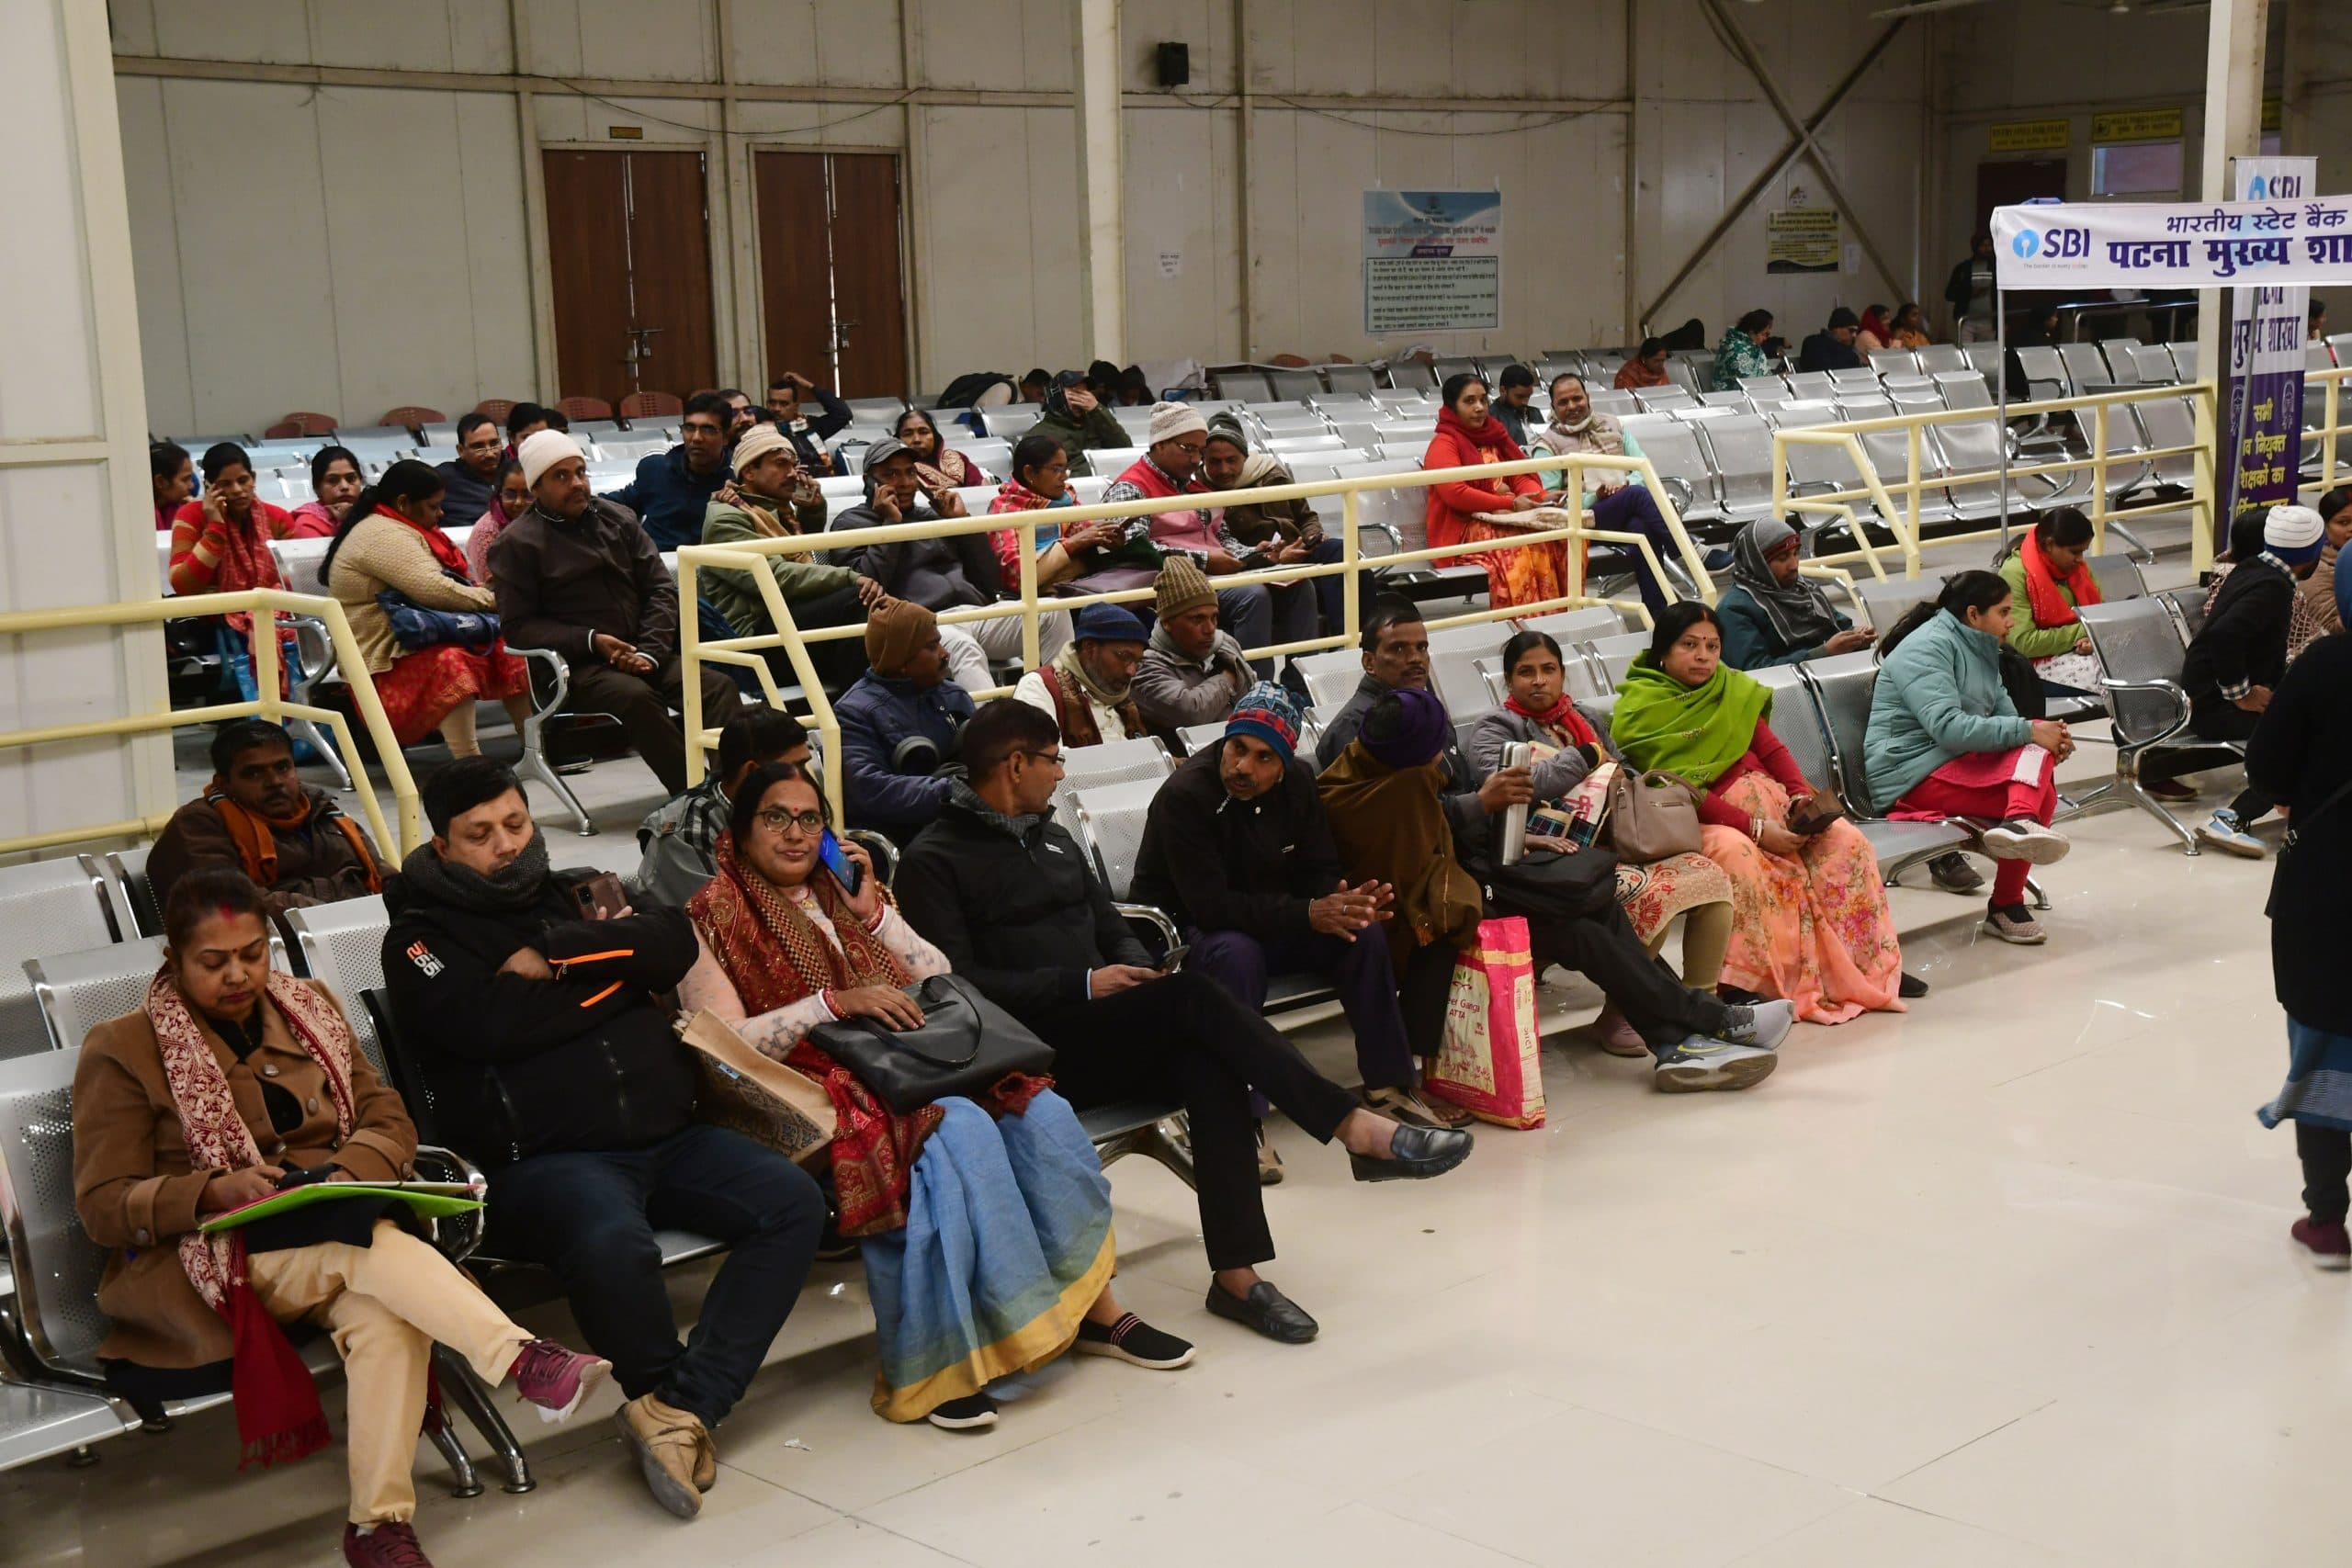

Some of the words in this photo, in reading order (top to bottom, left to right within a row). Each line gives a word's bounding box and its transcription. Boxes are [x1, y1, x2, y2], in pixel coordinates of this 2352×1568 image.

[2167, 210, 2242, 233] भारतीय
[2253, 207, 2296, 231] स्टेट
[2306, 203, 2347, 229] बैंक
[2042, 228, 2090, 258] SBI
[2108, 240, 2191, 268] पटना
[2203, 236, 2293, 277] मुख्य
[2268, 315, 2301, 352] शाखा
[2253, 397, 2274, 423] सभी
[2255, 430, 2288, 461] नियुक्त
[2271, 467, 2286, 484] का
[1449, 1009, 1465, 1019] ATTA
[1460, 999, 1481, 1013] Ganga
